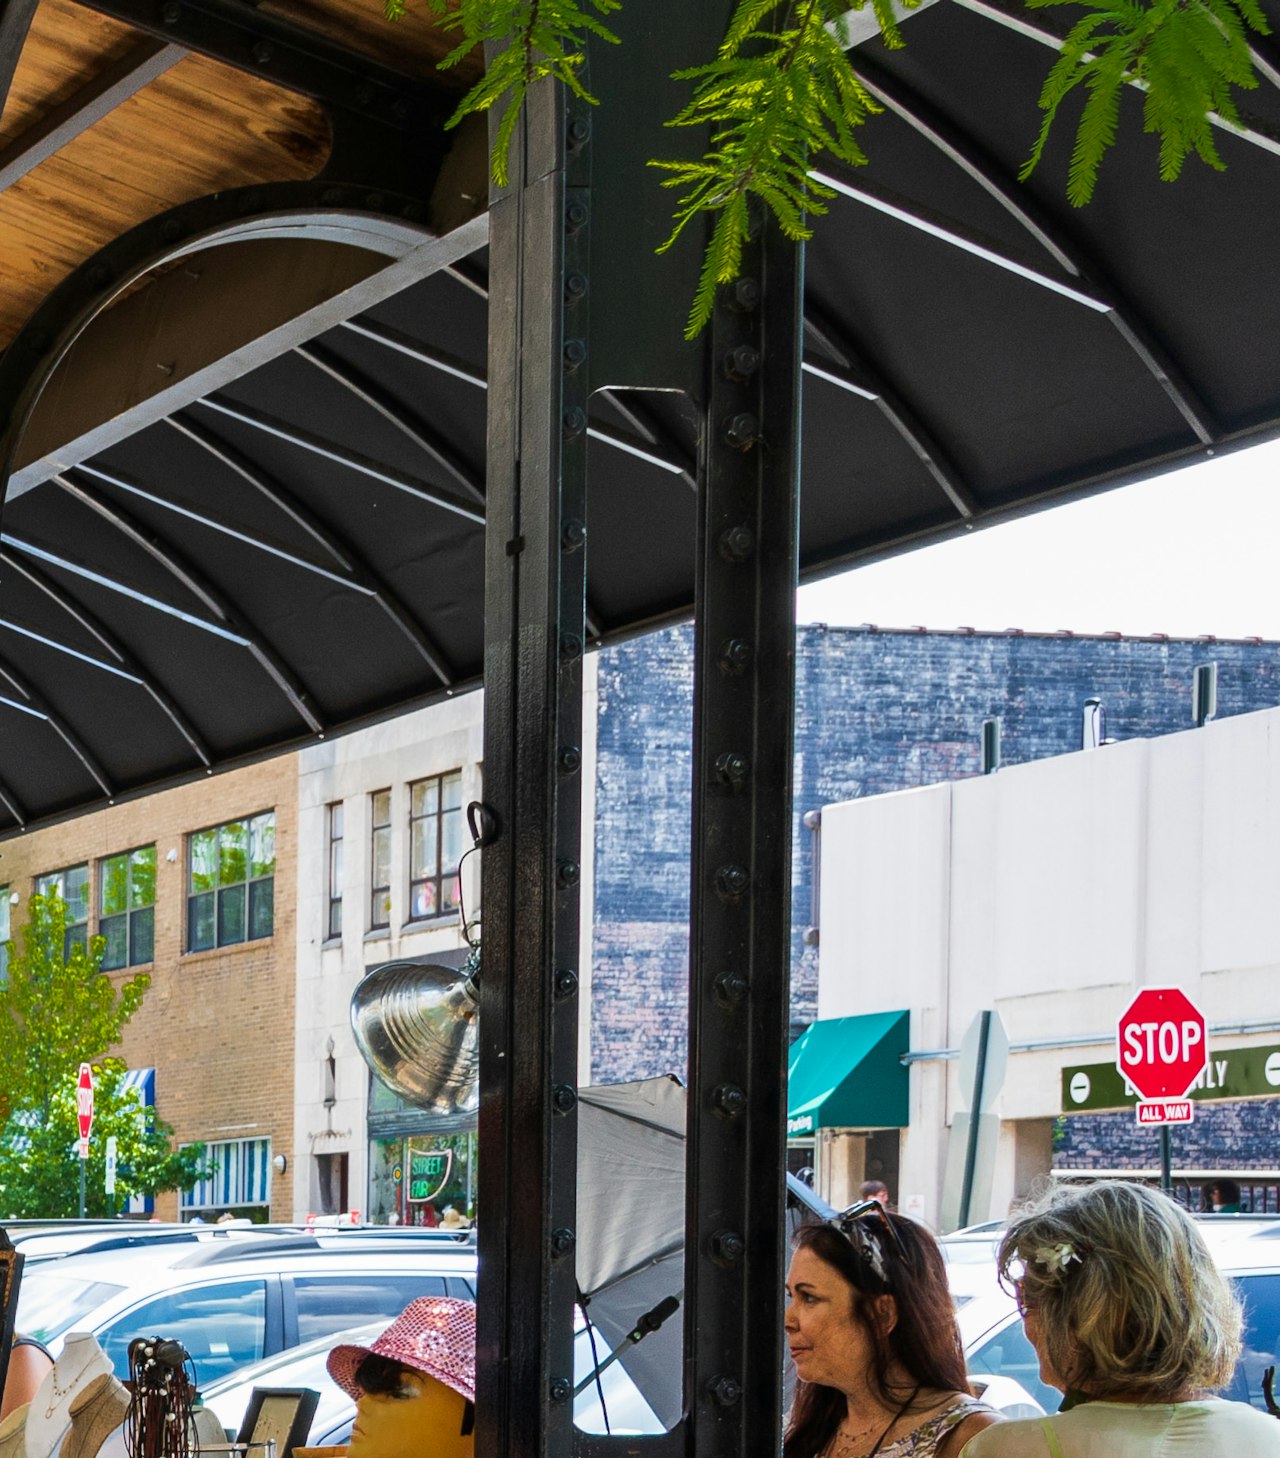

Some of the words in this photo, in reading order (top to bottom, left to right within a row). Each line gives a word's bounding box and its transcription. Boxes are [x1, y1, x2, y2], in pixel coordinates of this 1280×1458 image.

[1124, 1020, 1202, 1065] STOP
[1141, 1105, 1162, 1121] ALL
[1164, 1104, 1189, 1120] WAY
[412, 1157, 441, 1175] STREET
